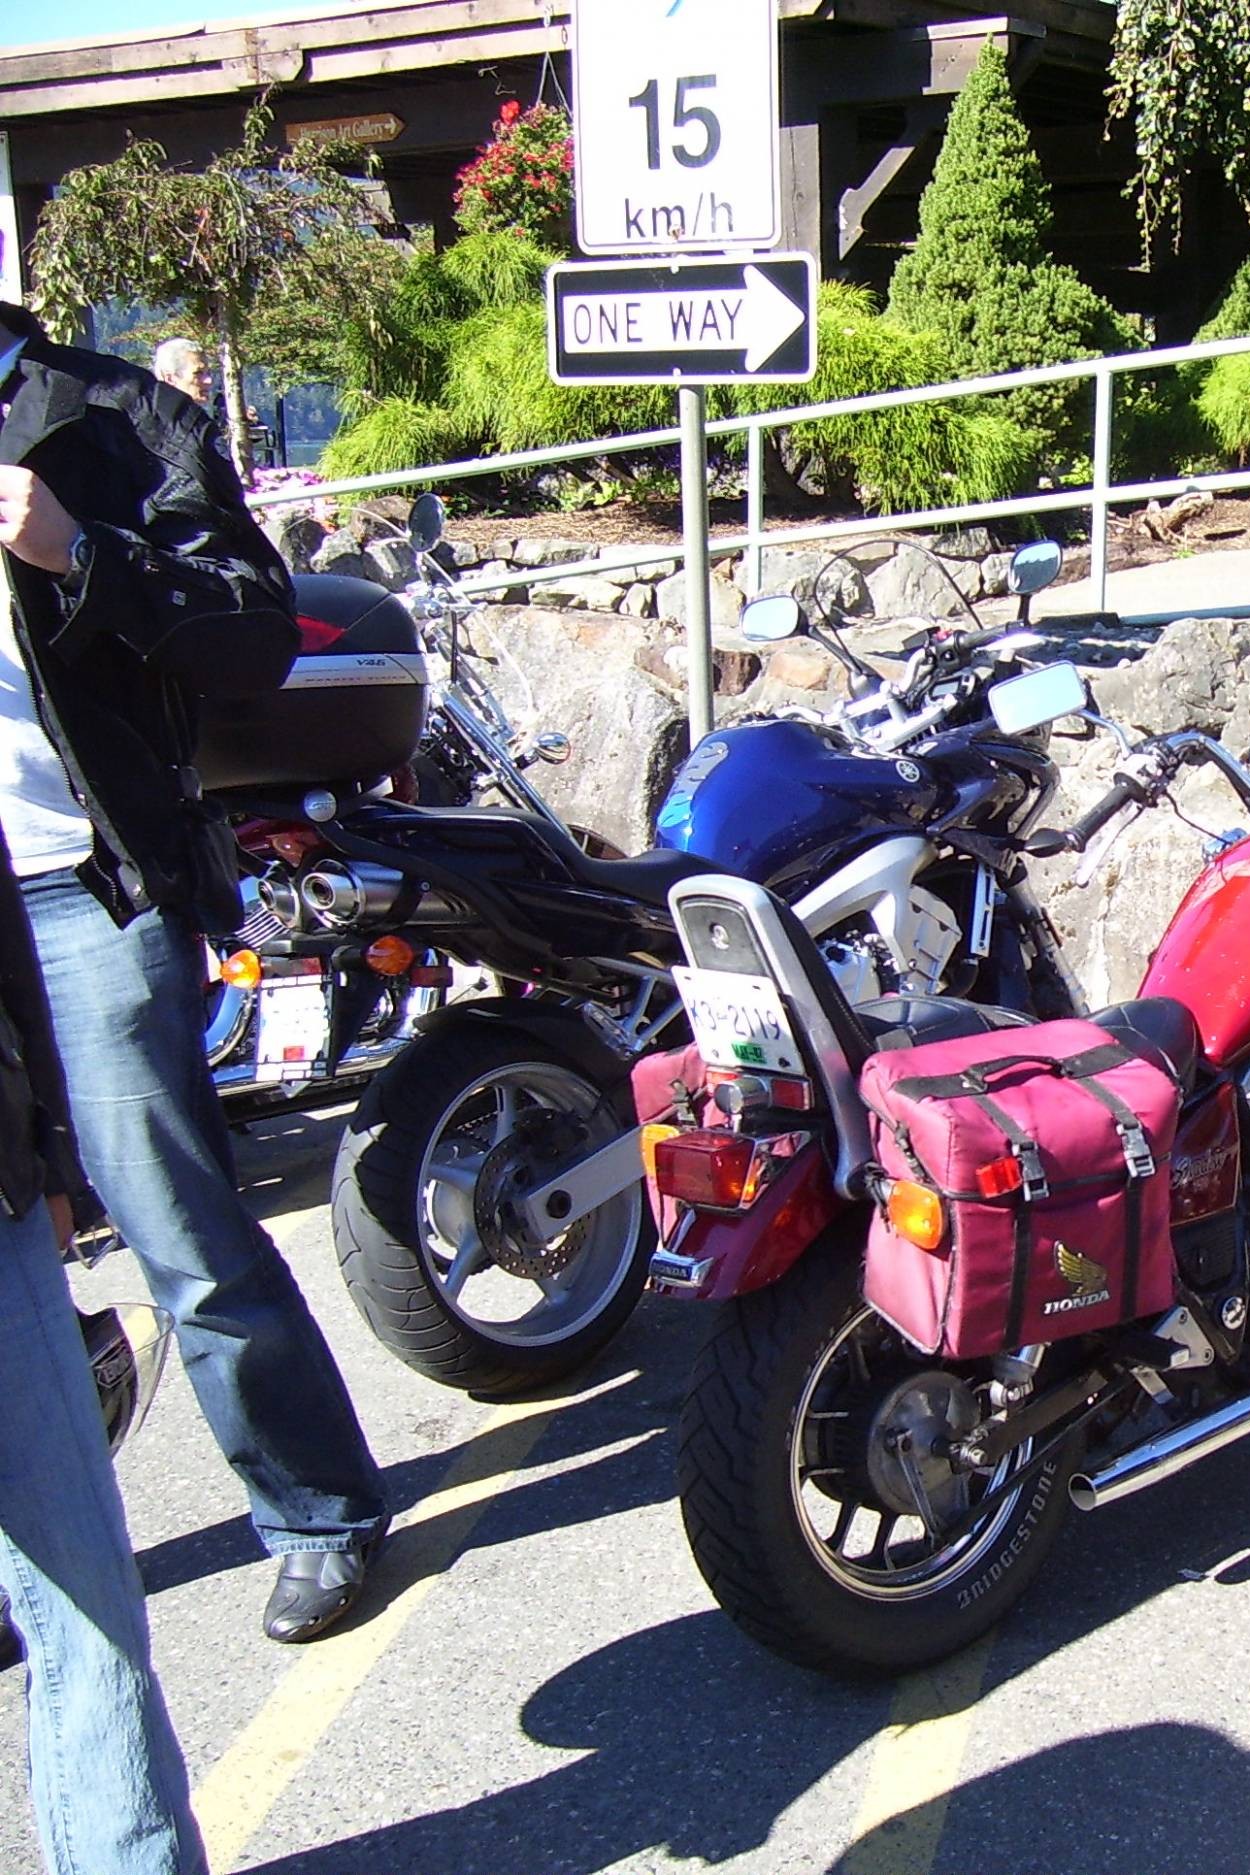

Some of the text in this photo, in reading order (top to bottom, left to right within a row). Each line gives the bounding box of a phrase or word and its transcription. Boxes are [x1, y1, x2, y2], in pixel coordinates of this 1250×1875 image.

[629, 73, 722, 171] 15
[625, 191, 735, 239] km/h
[573, 298, 744, 345] ONE WAY
[1043, 1289, 1111, 1315] HONDA
[957, 1460, 1057, 1609] BRIDGESTONE
